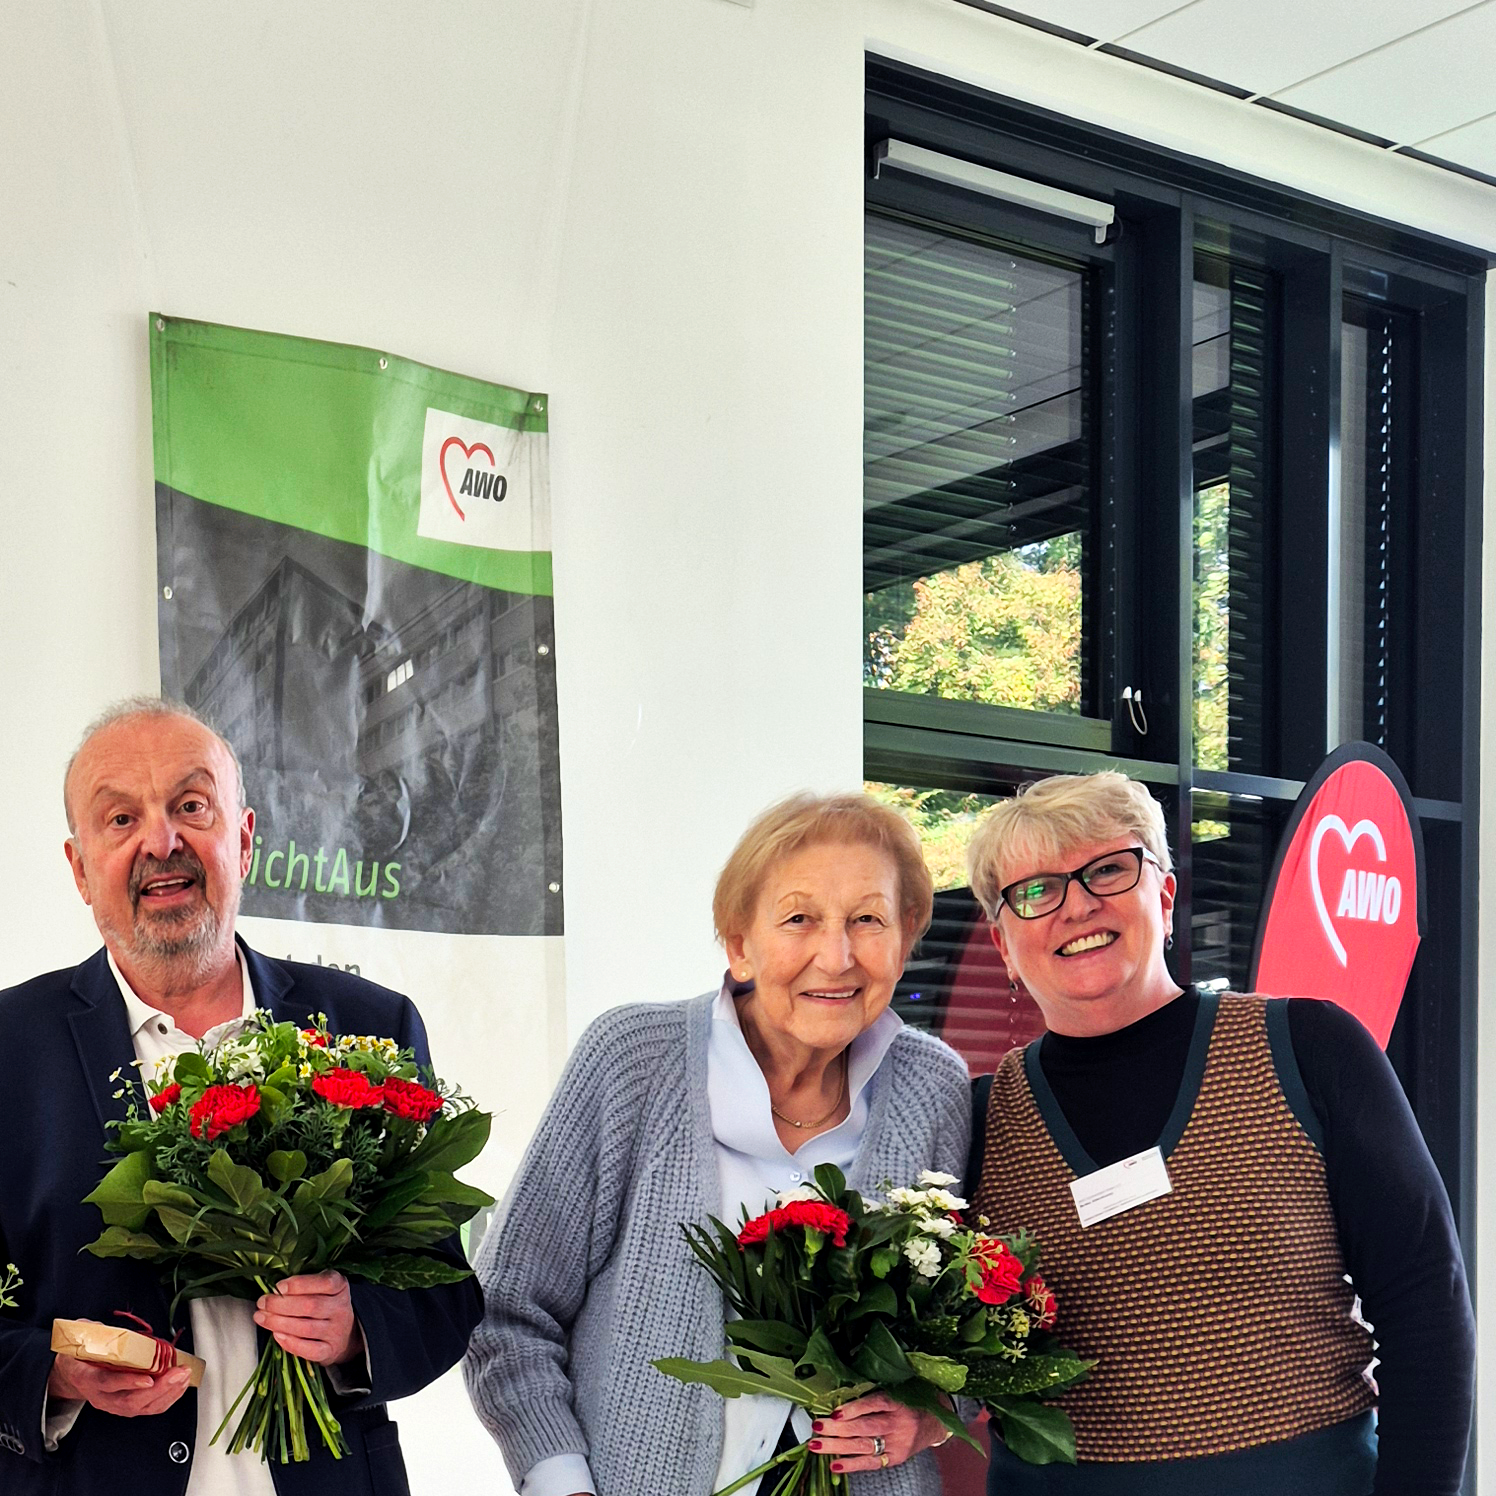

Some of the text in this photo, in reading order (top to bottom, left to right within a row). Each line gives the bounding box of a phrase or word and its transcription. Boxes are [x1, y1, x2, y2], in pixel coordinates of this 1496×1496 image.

[459, 467, 508, 503] AWO
[246, 835, 402, 899] ichtAus
[1336, 868, 1402, 925] AWO
